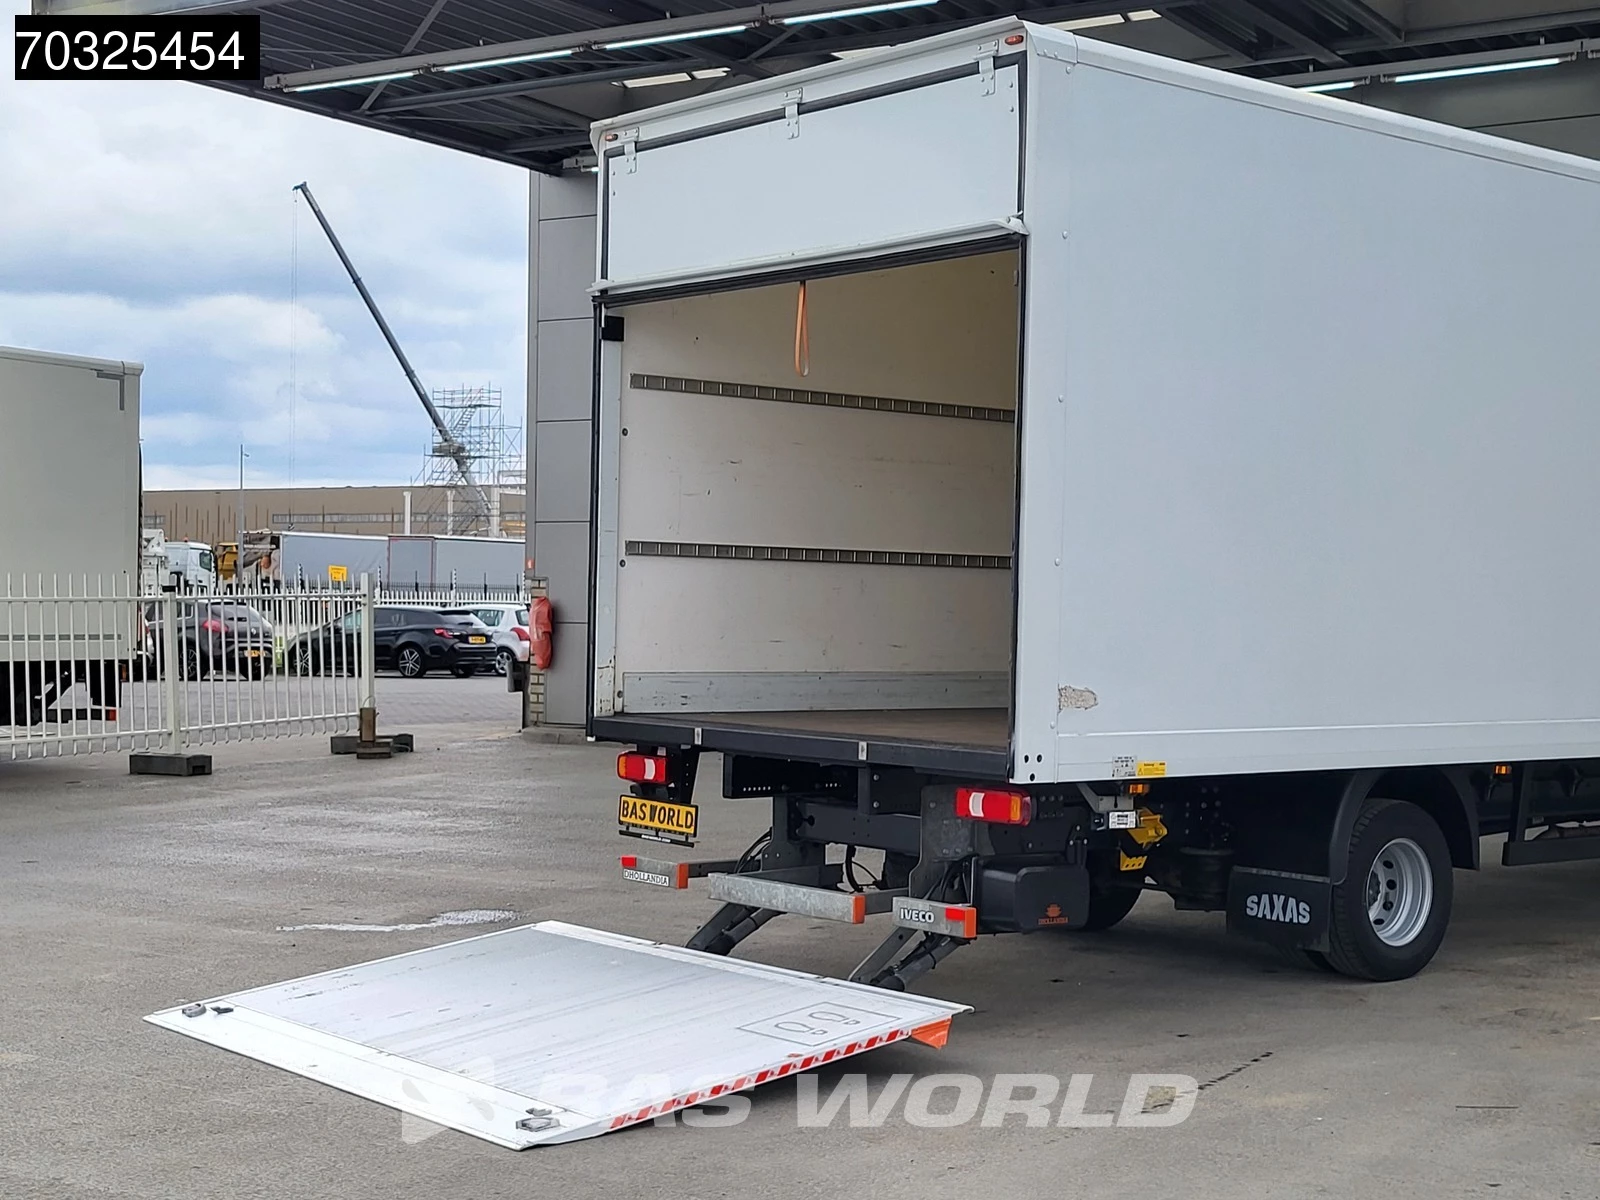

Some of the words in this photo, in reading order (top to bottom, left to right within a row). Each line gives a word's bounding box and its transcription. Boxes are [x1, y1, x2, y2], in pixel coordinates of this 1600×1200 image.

[621, 799, 647, 821] BAS
[649, 804, 694, 829] WORLD
[624, 869, 669, 886] DHOLLANDIA
[899, 907, 935, 923] IVECO
[1246, 893, 1310, 924] SAXAS
